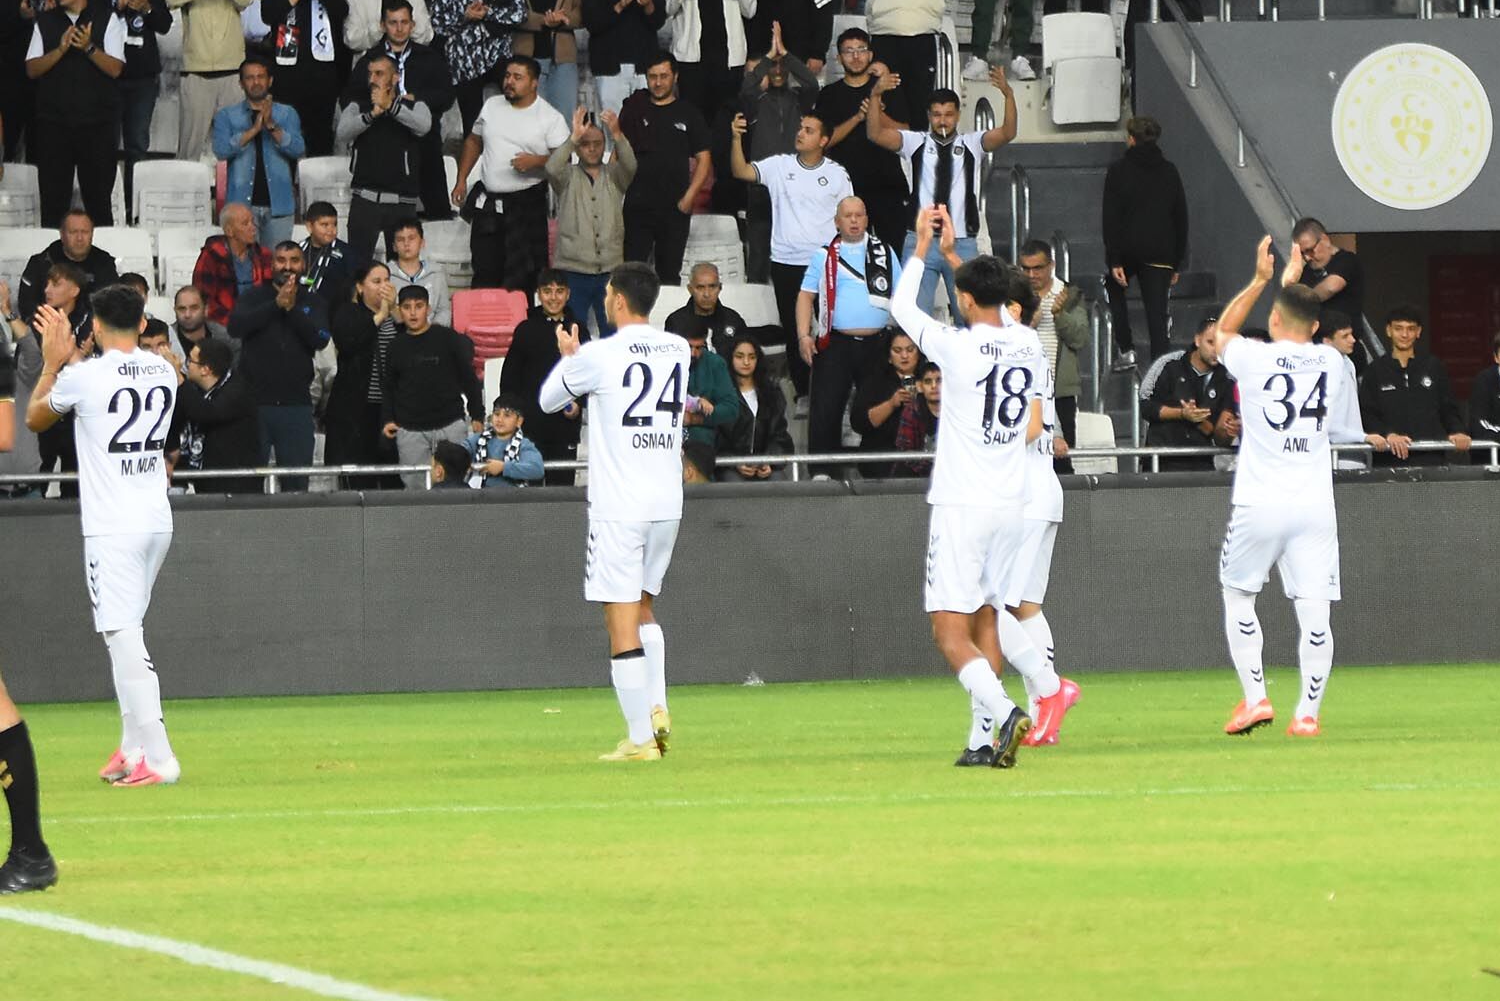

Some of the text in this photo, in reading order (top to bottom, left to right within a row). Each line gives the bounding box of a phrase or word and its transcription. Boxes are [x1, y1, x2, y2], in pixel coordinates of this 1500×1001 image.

[108, 386, 173, 453] 22
[622, 362, 684, 427] 24
[976, 364, 1033, 428] 18
[1263, 371, 1328, 432] 34
[632, 432, 676, 449] OSMAN
[1283, 437, 1311, 453] ANIL
